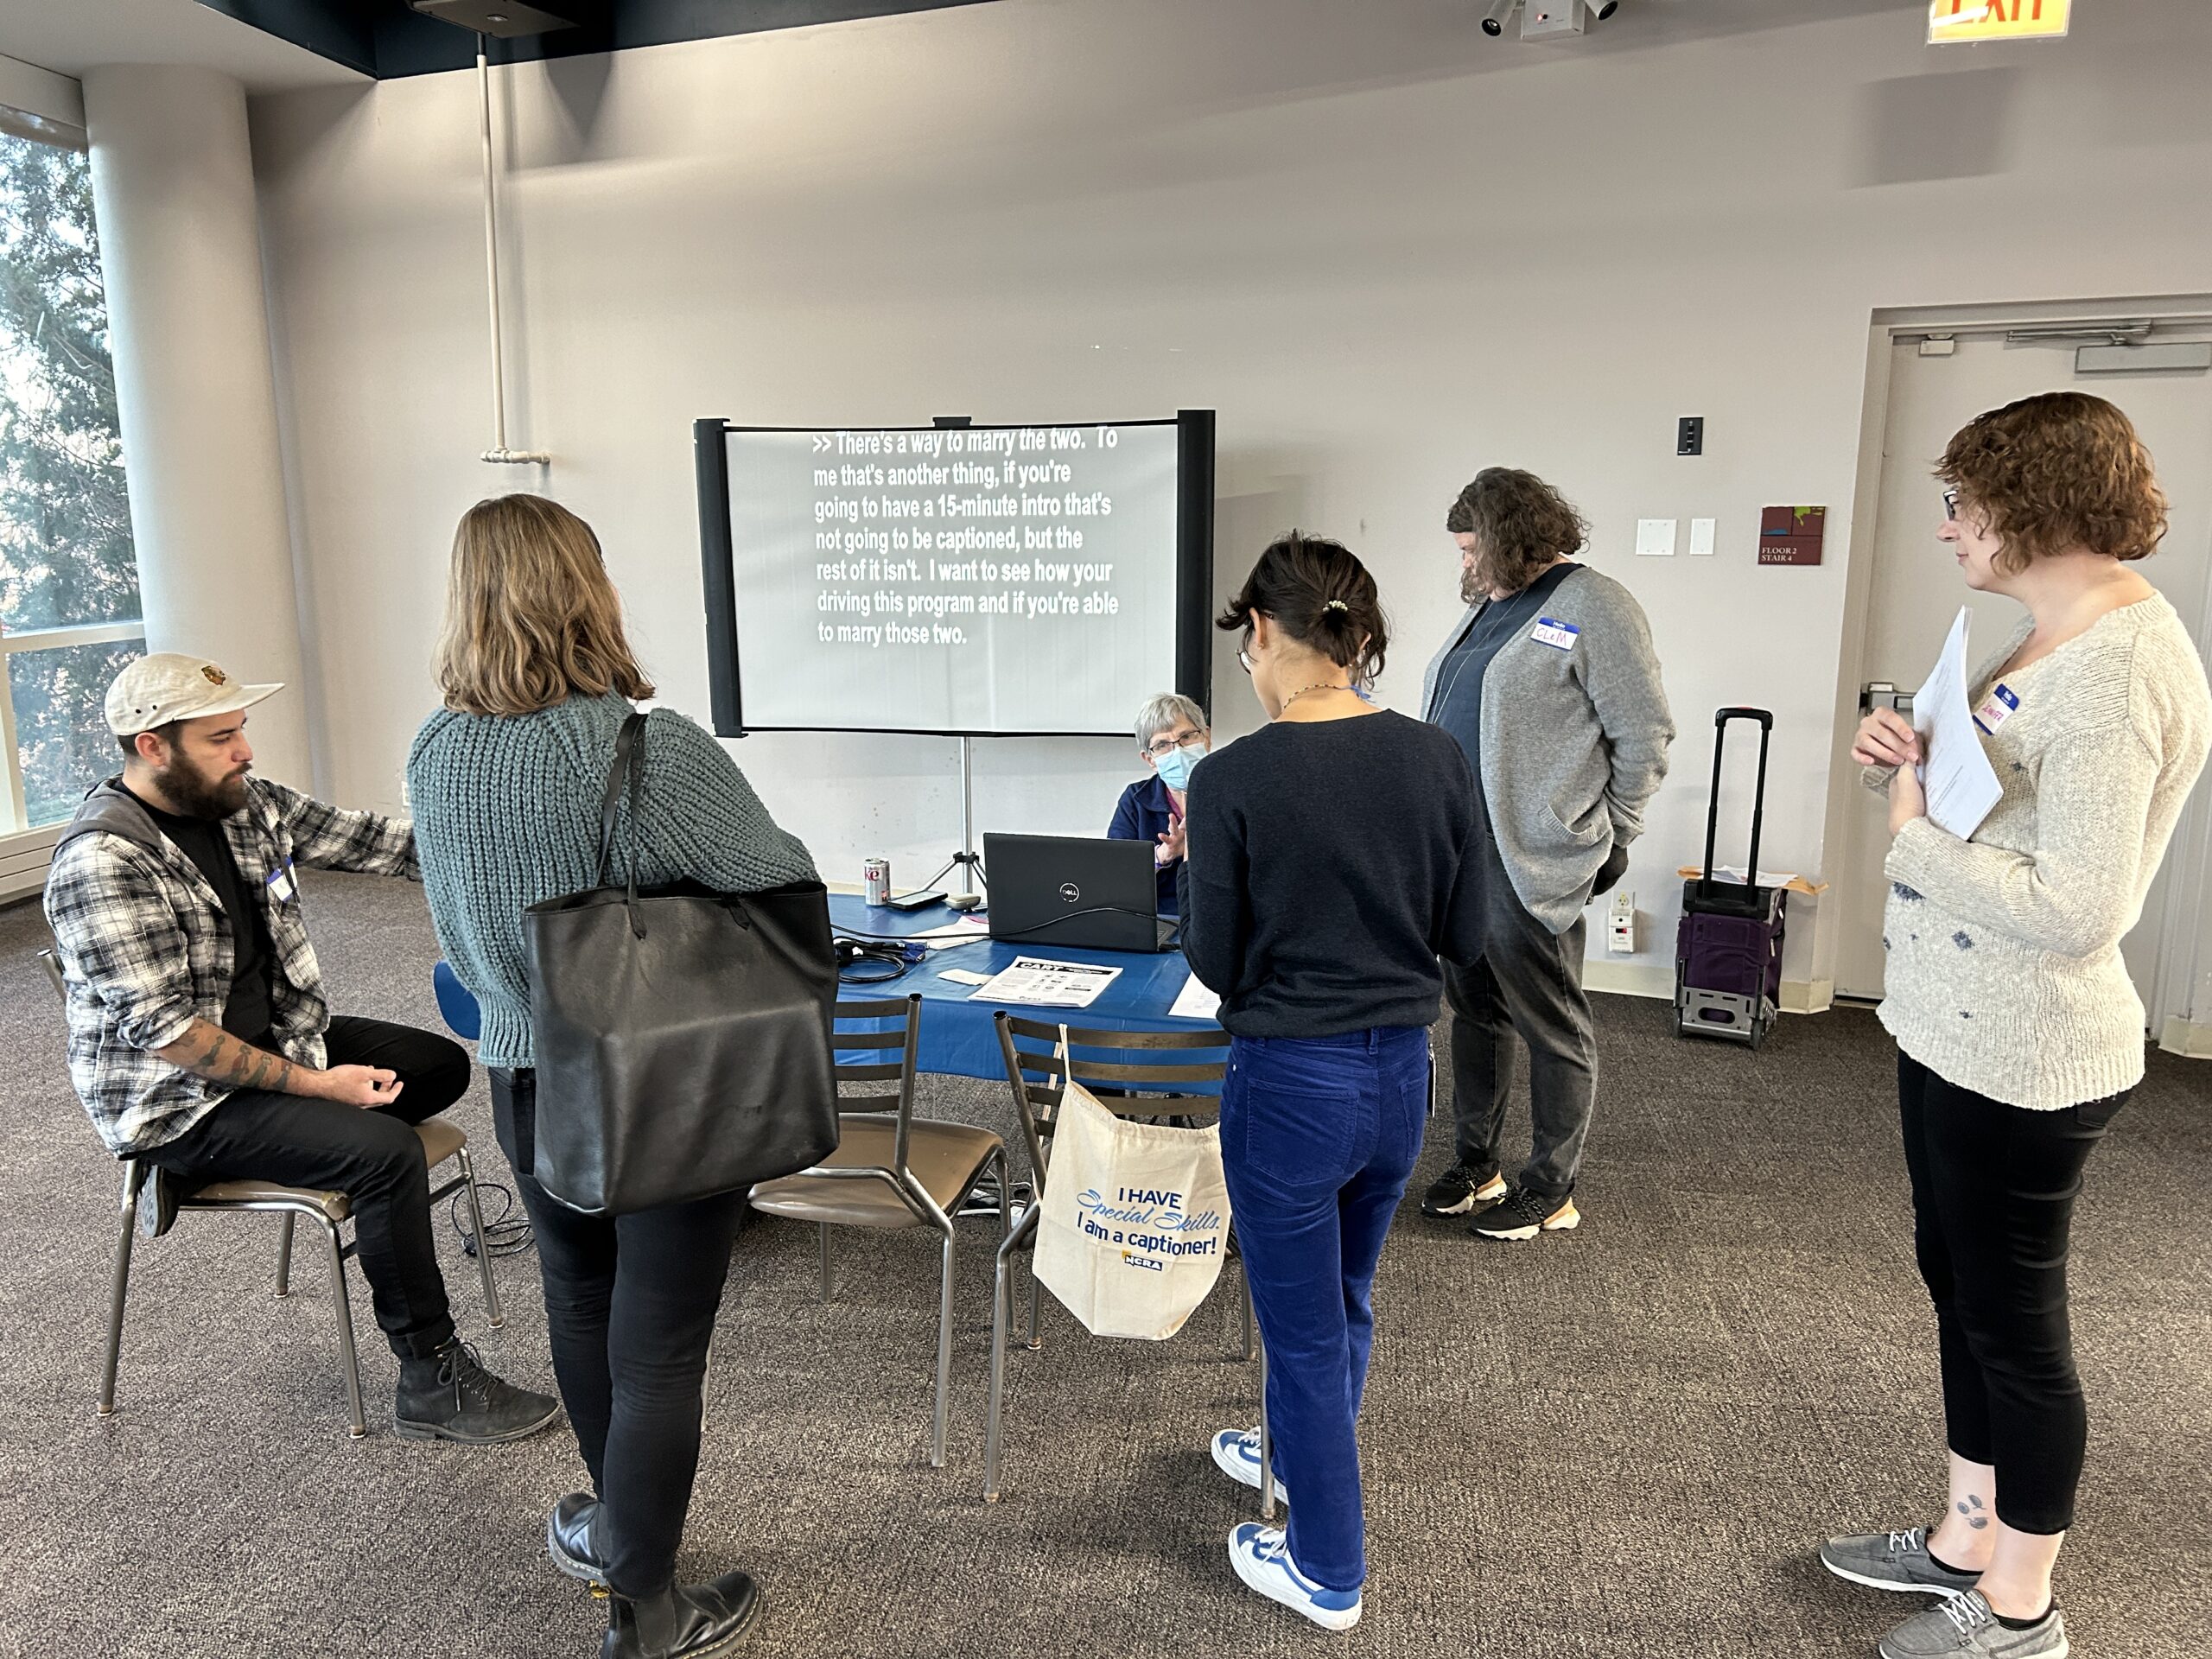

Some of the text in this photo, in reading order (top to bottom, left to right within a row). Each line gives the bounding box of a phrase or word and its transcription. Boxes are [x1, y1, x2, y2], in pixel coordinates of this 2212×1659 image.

[836, 431, 893, 454] There's
[897, 435, 907, 454] a
[911, 433, 944, 458] way
[947, 430, 963, 453] to
[967, 432, 1016, 456] marry
[1020, 429, 1046, 451] the
[1050, 428, 1086, 449] two.
[1096, 425, 1118, 448] To
[814, 459, 1071, 489] me that's another thing, if you're
[815, 492, 1112, 523] going to have a 15-minute intro that's
[816, 525, 1084, 555] not going to be captioned, but the
[817, 558, 1113, 588] rest of it isn't. I want to see how your
[817, 589, 1119, 620] driving this program and if you're able
[817, 621, 968, 648] to marry those two.
[863, 866, 880, 882] ke
[1020, 963, 1064, 971] CART
[1077, 1189, 1220, 1231] Special Skills.
[1118, 1187, 1182, 1210] I HAVE
[1077, 1211, 1217, 1255] I am a captioner!
[1125, 1255, 1162, 1270] NCRA
